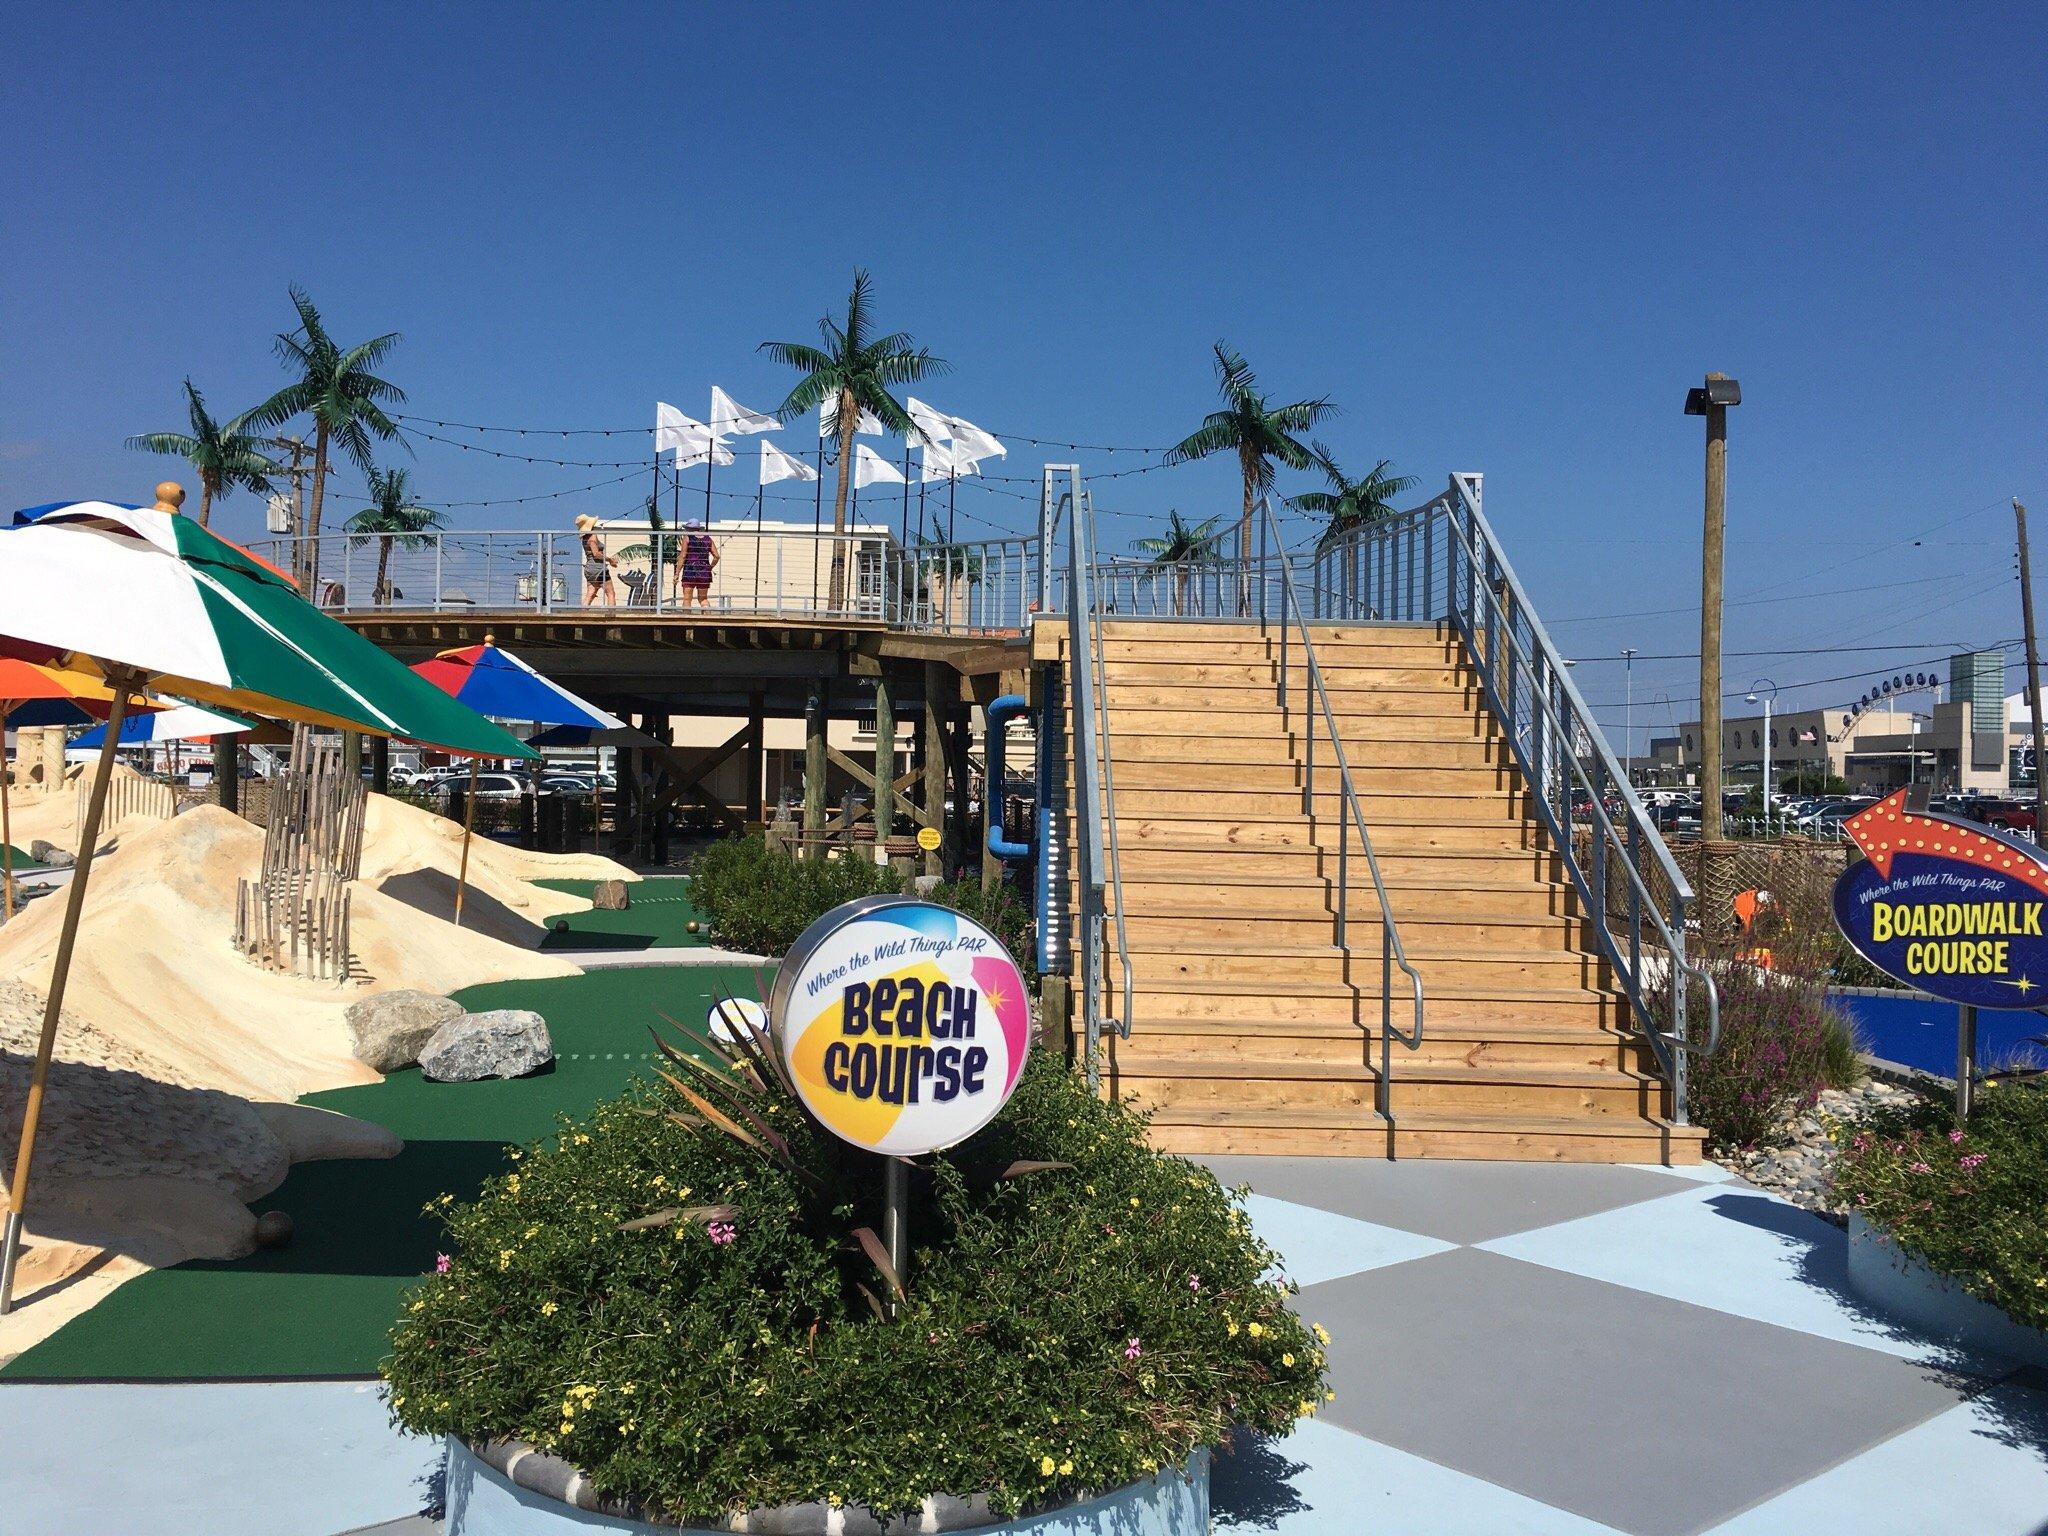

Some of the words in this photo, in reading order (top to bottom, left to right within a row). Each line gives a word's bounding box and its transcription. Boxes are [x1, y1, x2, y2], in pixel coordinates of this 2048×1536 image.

[1859, 885, 1892, 905] Where
[1892, 878, 1909, 891] the
[1912, 874, 1938, 887] Wild
[1940, 873, 1977, 893] Things
[1978, 878, 2006, 893] PAR
[1873, 902, 2044, 942] BOARDWALK
[806, 964, 848, 997] Where
[849, 952, 871, 971] the
[874, 939, 906, 962] Wild
[910, 936, 954, 959] Things
[956, 936, 988, 953] PAR
[1906, 941, 2009, 975] COURSE
